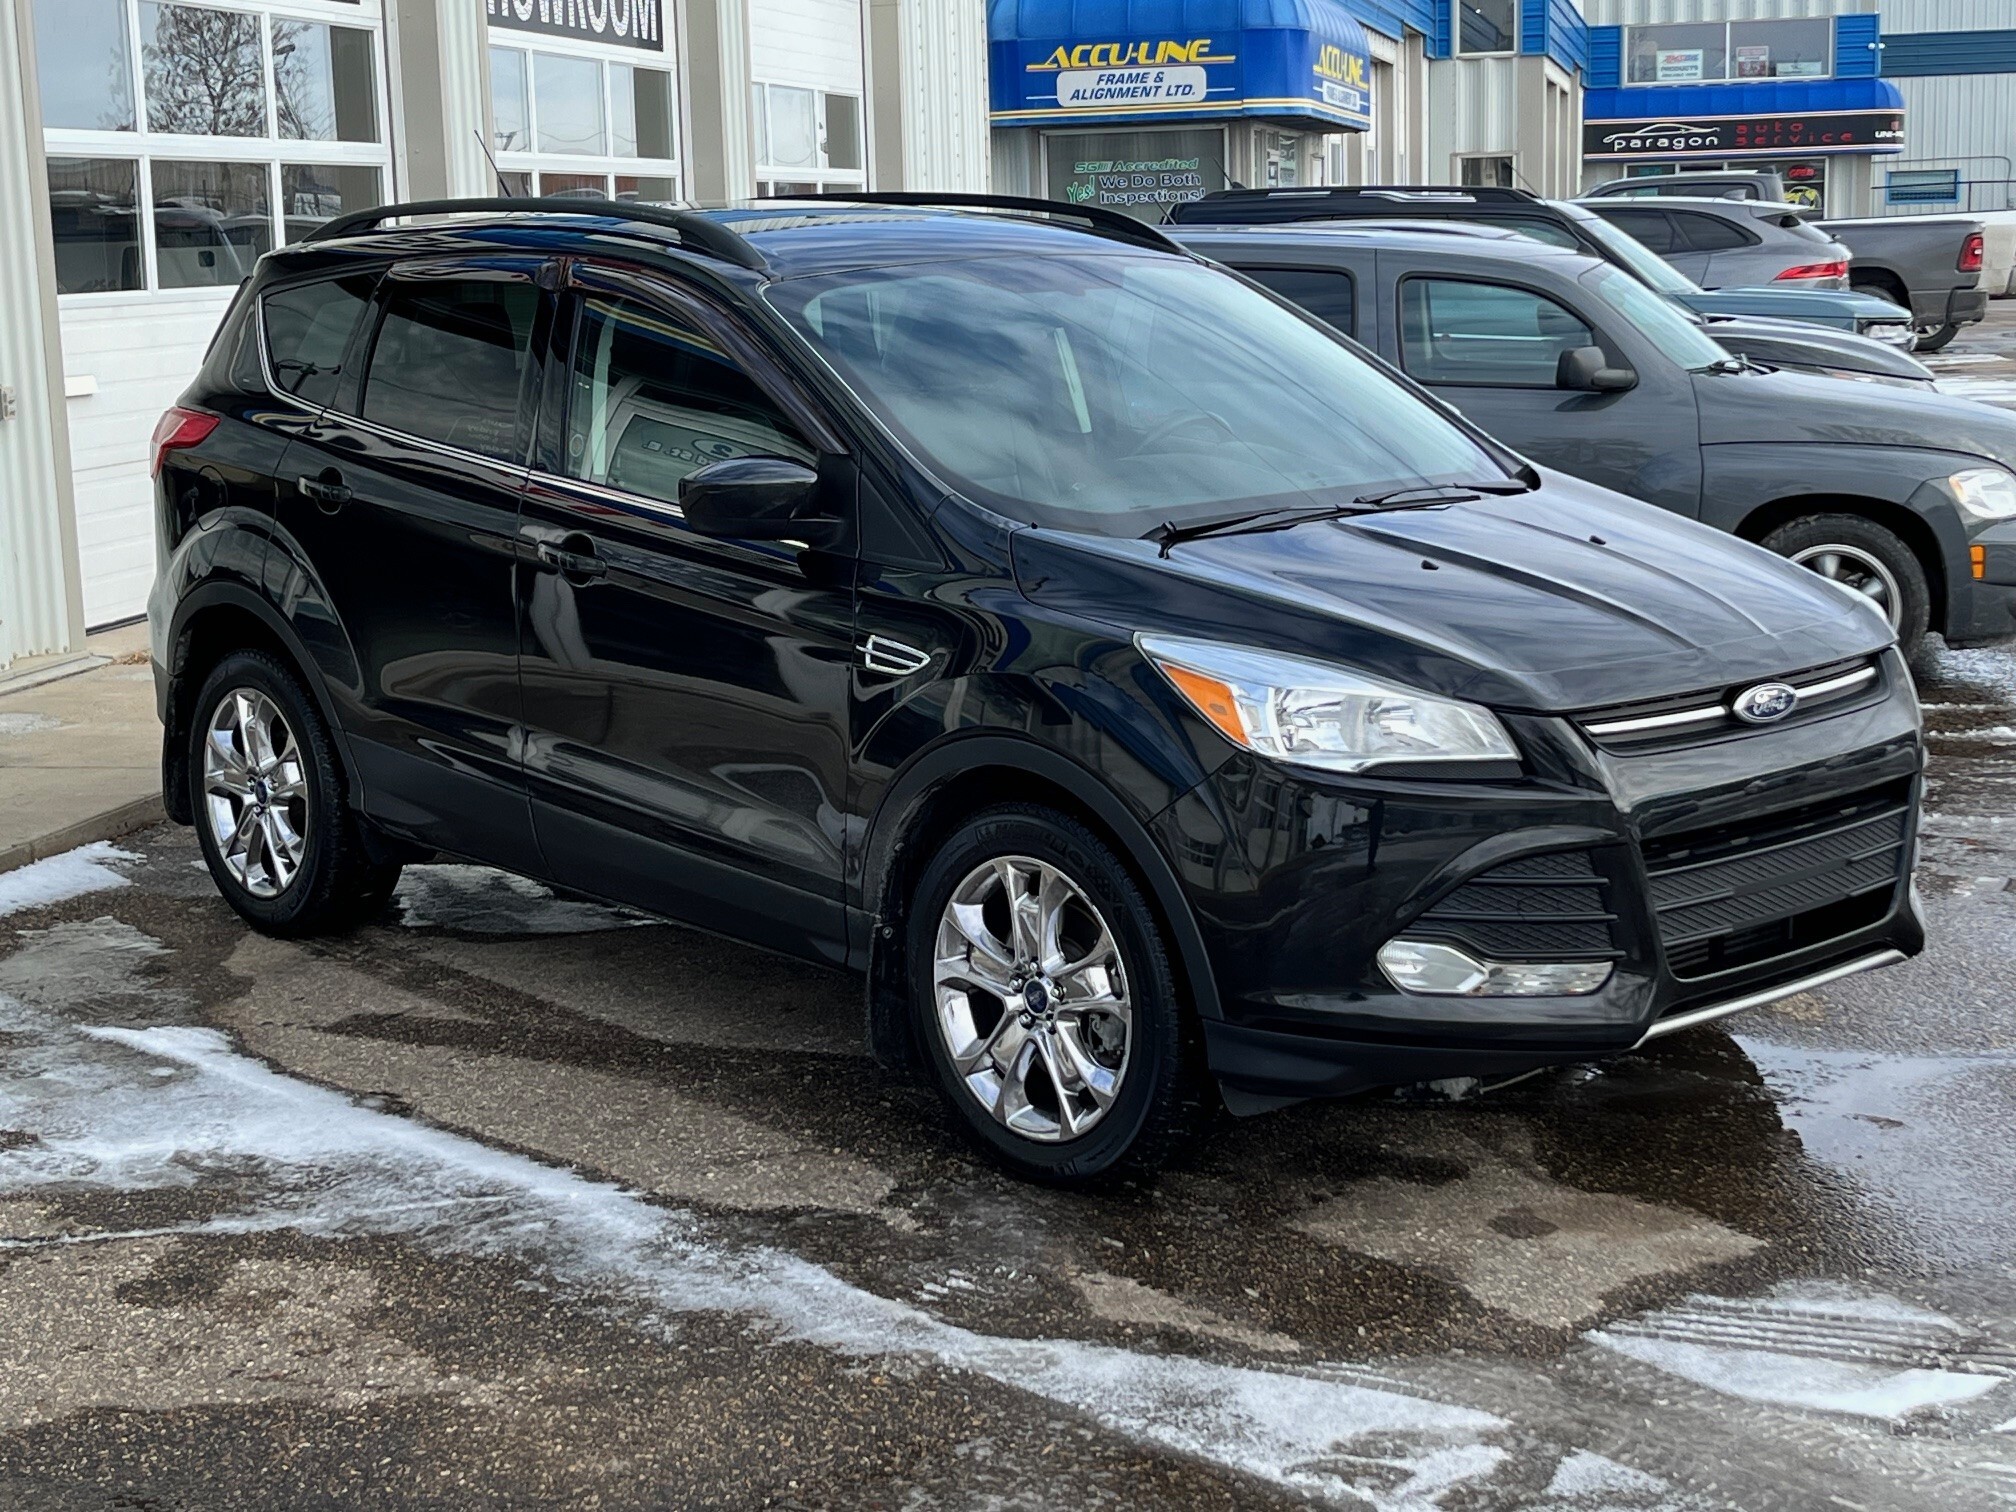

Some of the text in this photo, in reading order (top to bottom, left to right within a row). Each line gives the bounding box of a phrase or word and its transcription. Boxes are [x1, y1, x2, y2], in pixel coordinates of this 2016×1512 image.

[1040, 38, 1213, 69] ACCU-LINE
[1096, 71, 1165, 86] FRAME &
[1069, 84, 1196, 101] ALIGNMENT LTD.
[1736, 121, 1804, 135] auto
[1614, 136, 1719, 151] paragon
[1735, 131, 1853, 146] service
[1112, 158, 1199, 172] Accredited
[1100, 173, 1202, 188] We Do Both
[1067, 175, 1096, 203] Yes!
[1100, 187, 1206, 206] Inspections!
